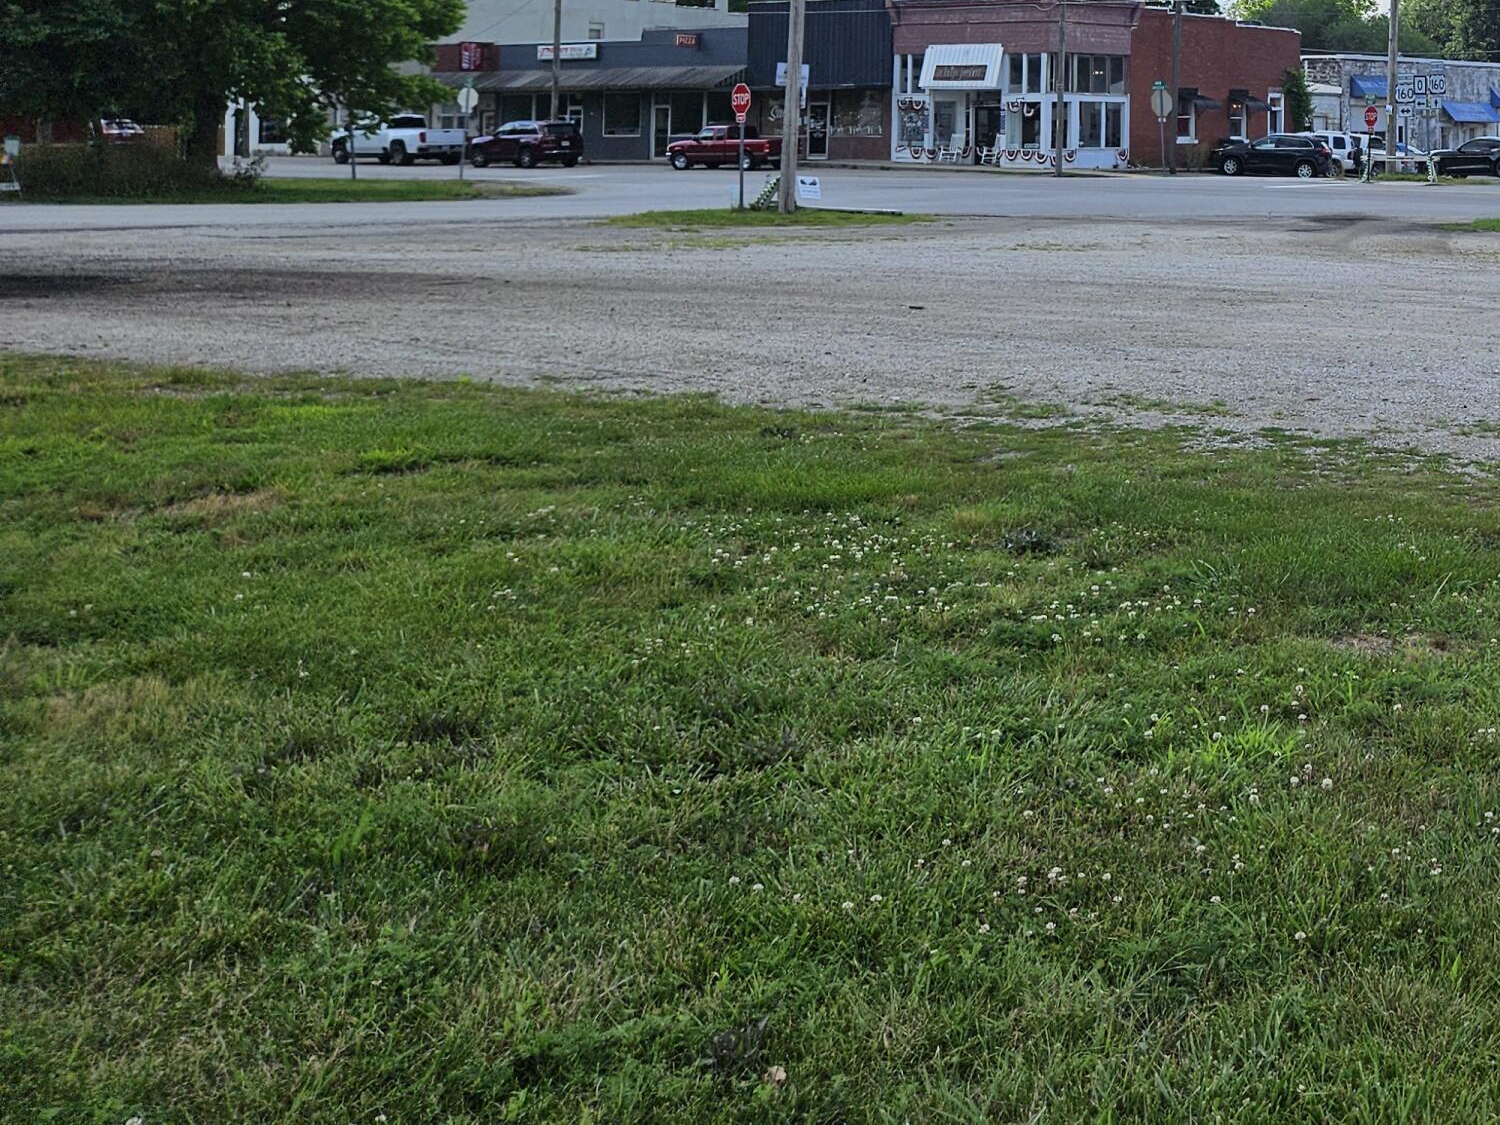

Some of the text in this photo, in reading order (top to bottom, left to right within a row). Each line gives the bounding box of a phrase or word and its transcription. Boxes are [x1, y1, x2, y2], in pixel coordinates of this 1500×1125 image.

[679, 36, 696, 44] PIZZA
[1431, 79, 1444, 90] 160
[733, 94, 749, 105] STOP
[1397, 88, 1414, 100] 160
[1365, 112, 1377, 121] STOP
